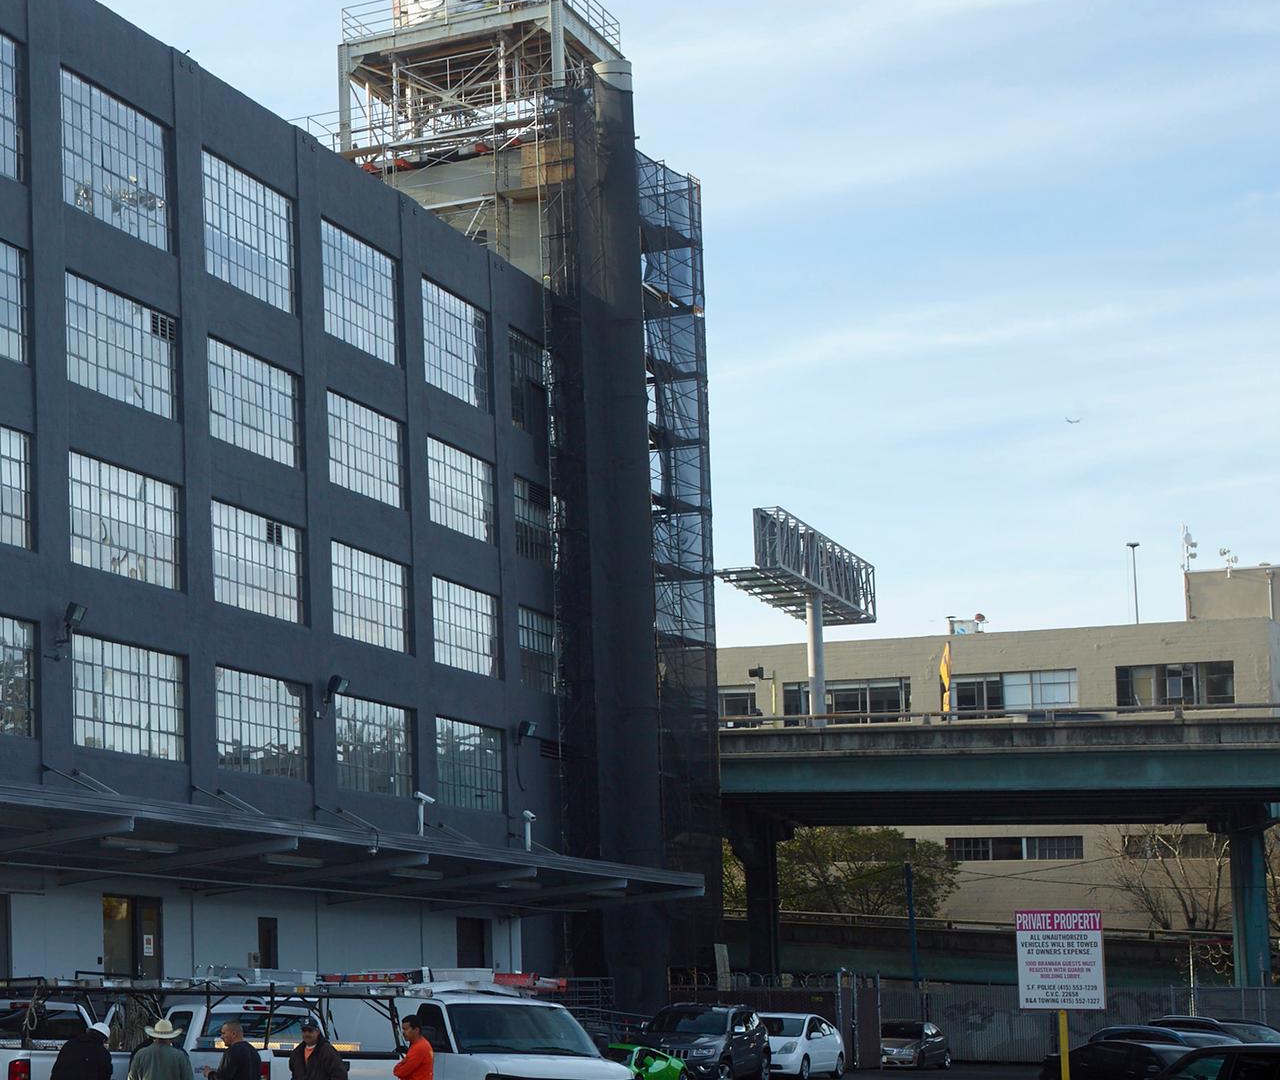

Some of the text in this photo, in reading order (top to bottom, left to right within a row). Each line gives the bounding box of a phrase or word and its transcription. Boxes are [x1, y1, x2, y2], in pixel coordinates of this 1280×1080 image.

[1016, 912, 1101, 930] PRIVATE PROPERTY
[1057, 984, 1072, 992] (415)
